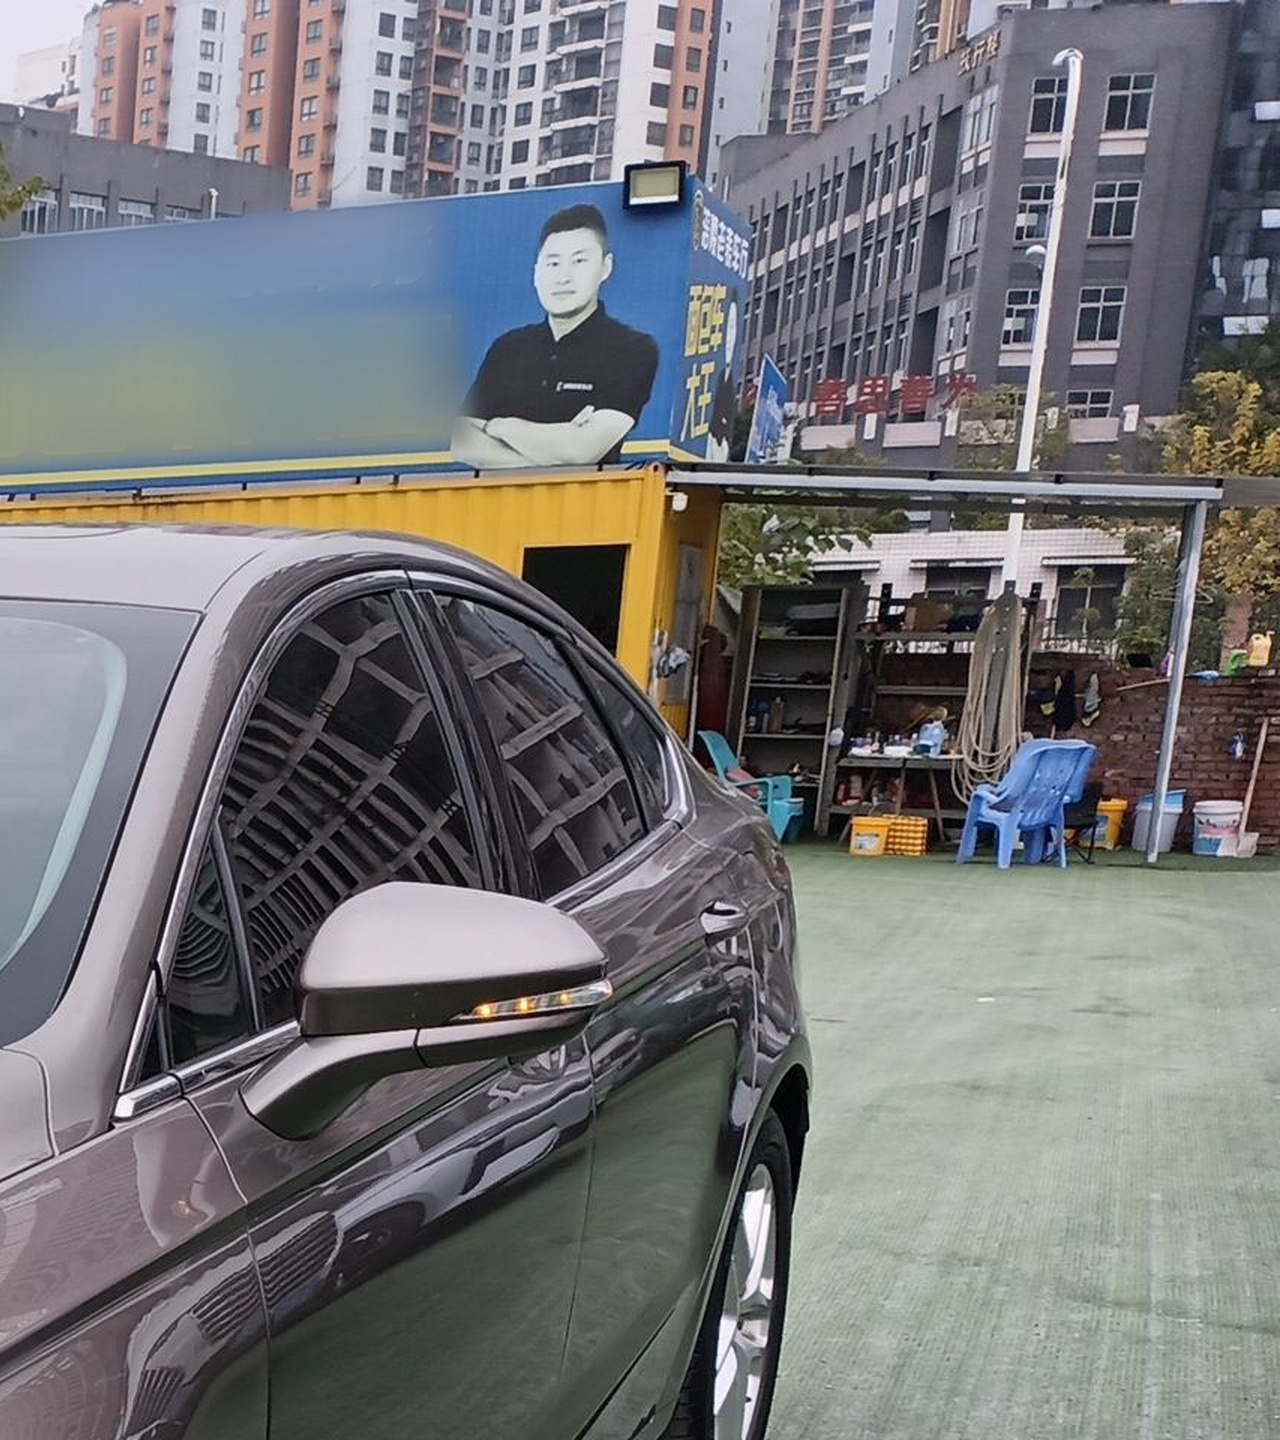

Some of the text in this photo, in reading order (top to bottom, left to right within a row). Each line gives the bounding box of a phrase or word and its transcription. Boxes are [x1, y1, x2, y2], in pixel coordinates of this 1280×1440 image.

[685, 284, 727, 358] 面包车
[680, 361, 716, 443] 大王
